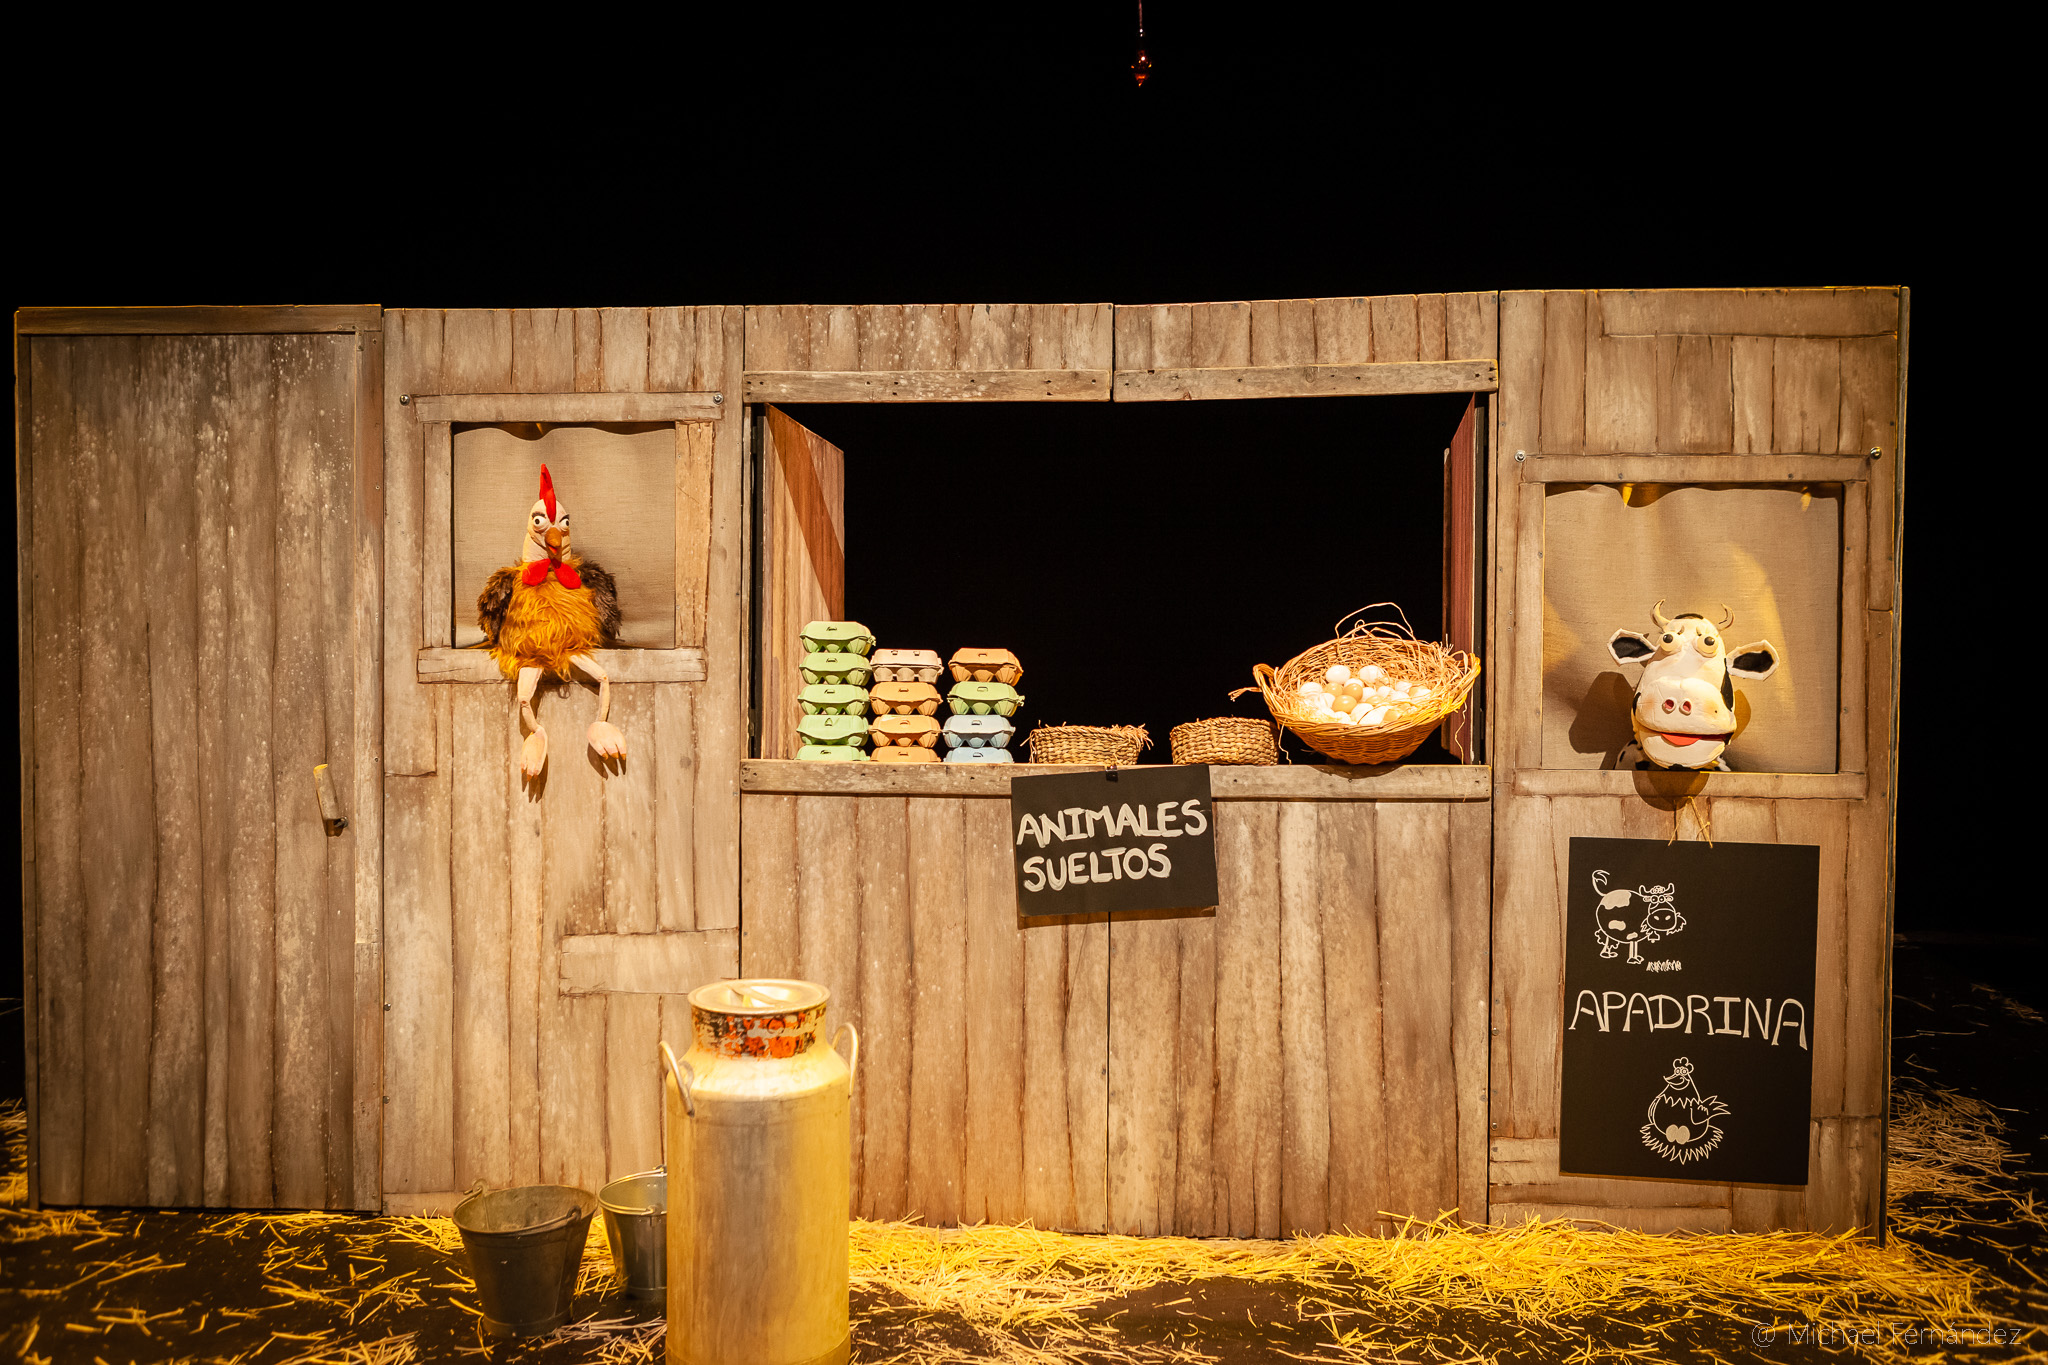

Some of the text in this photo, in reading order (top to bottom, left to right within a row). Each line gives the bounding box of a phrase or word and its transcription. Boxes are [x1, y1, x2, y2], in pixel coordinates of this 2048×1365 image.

[1016, 799, 1208, 848] ANIMALES
[1023, 843, 1172, 892] SUELTOS
[1568, 989, 1808, 1051] APADRINA
